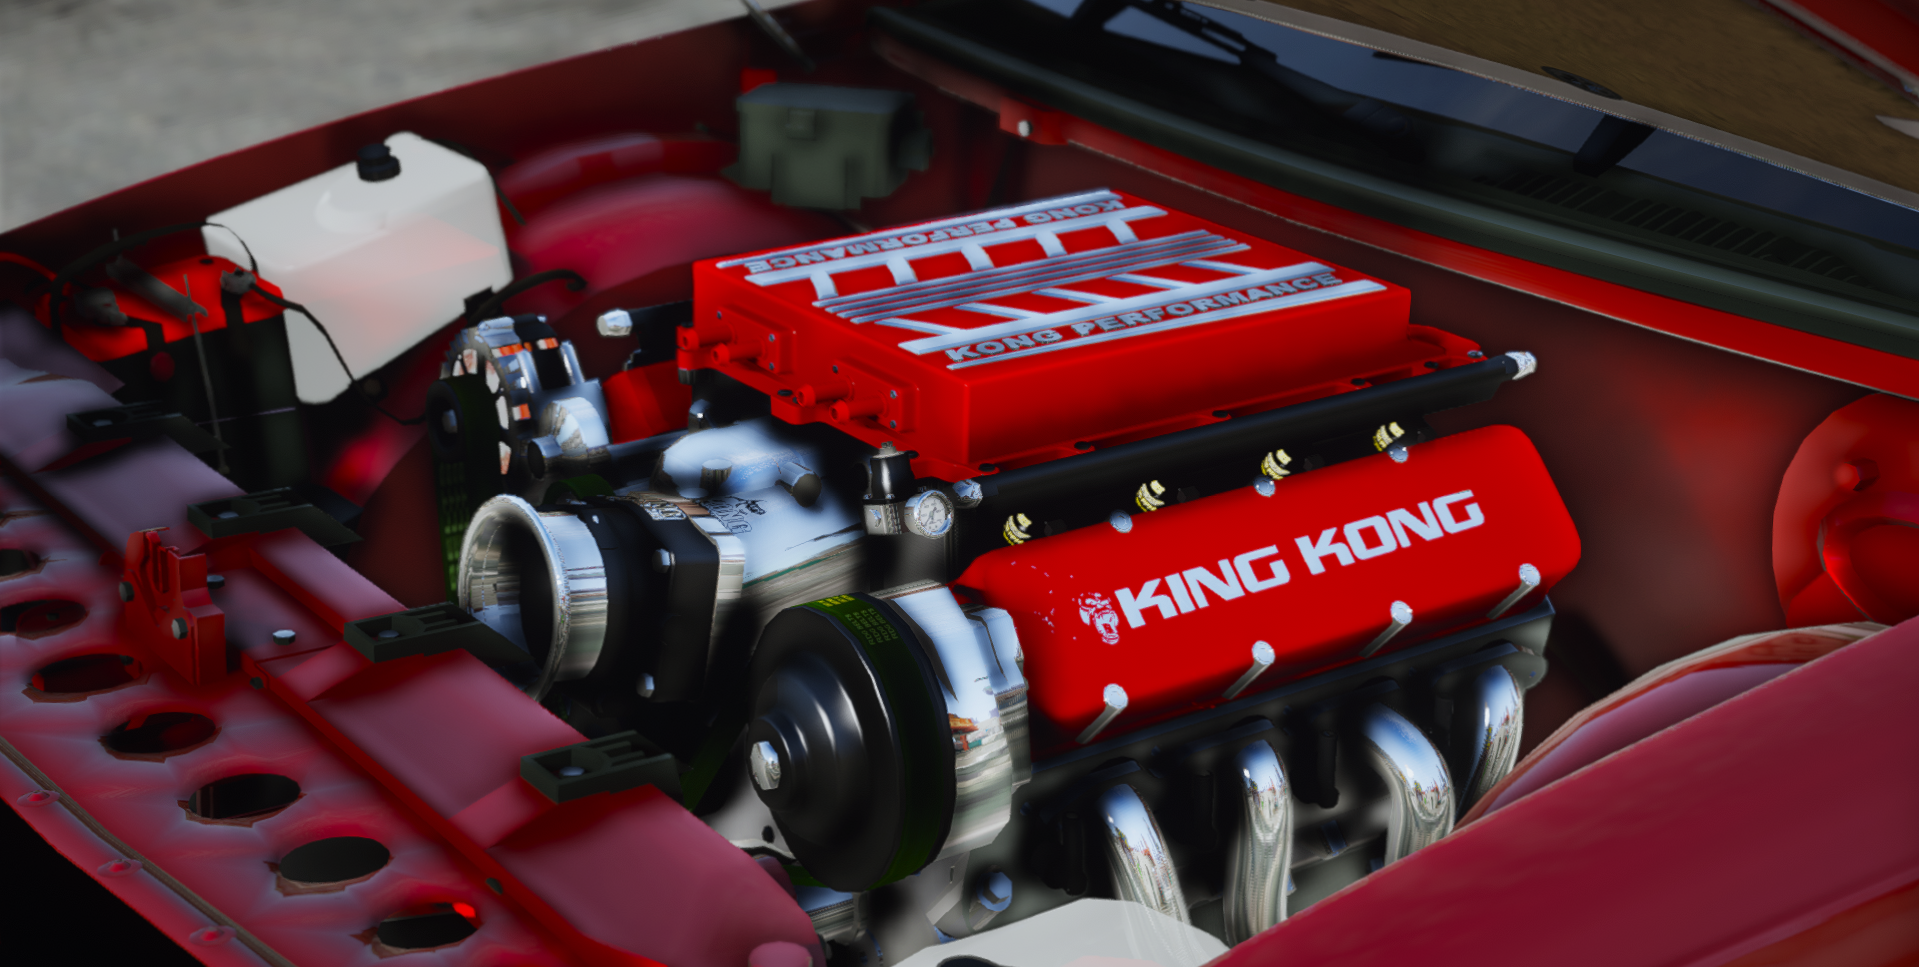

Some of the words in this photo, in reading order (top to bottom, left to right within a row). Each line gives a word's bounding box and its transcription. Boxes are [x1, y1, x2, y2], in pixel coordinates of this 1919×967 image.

[743, 216, 1018, 273] PERFORMANCE
[1022, 199, 1127, 224] KONG
[944, 328, 1064, 363] KONG
[1070, 272, 1343, 338] PERFORMANCE
[1114, 544, 1291, 629] KING
[1294, 489, 1485, 576] KONG
